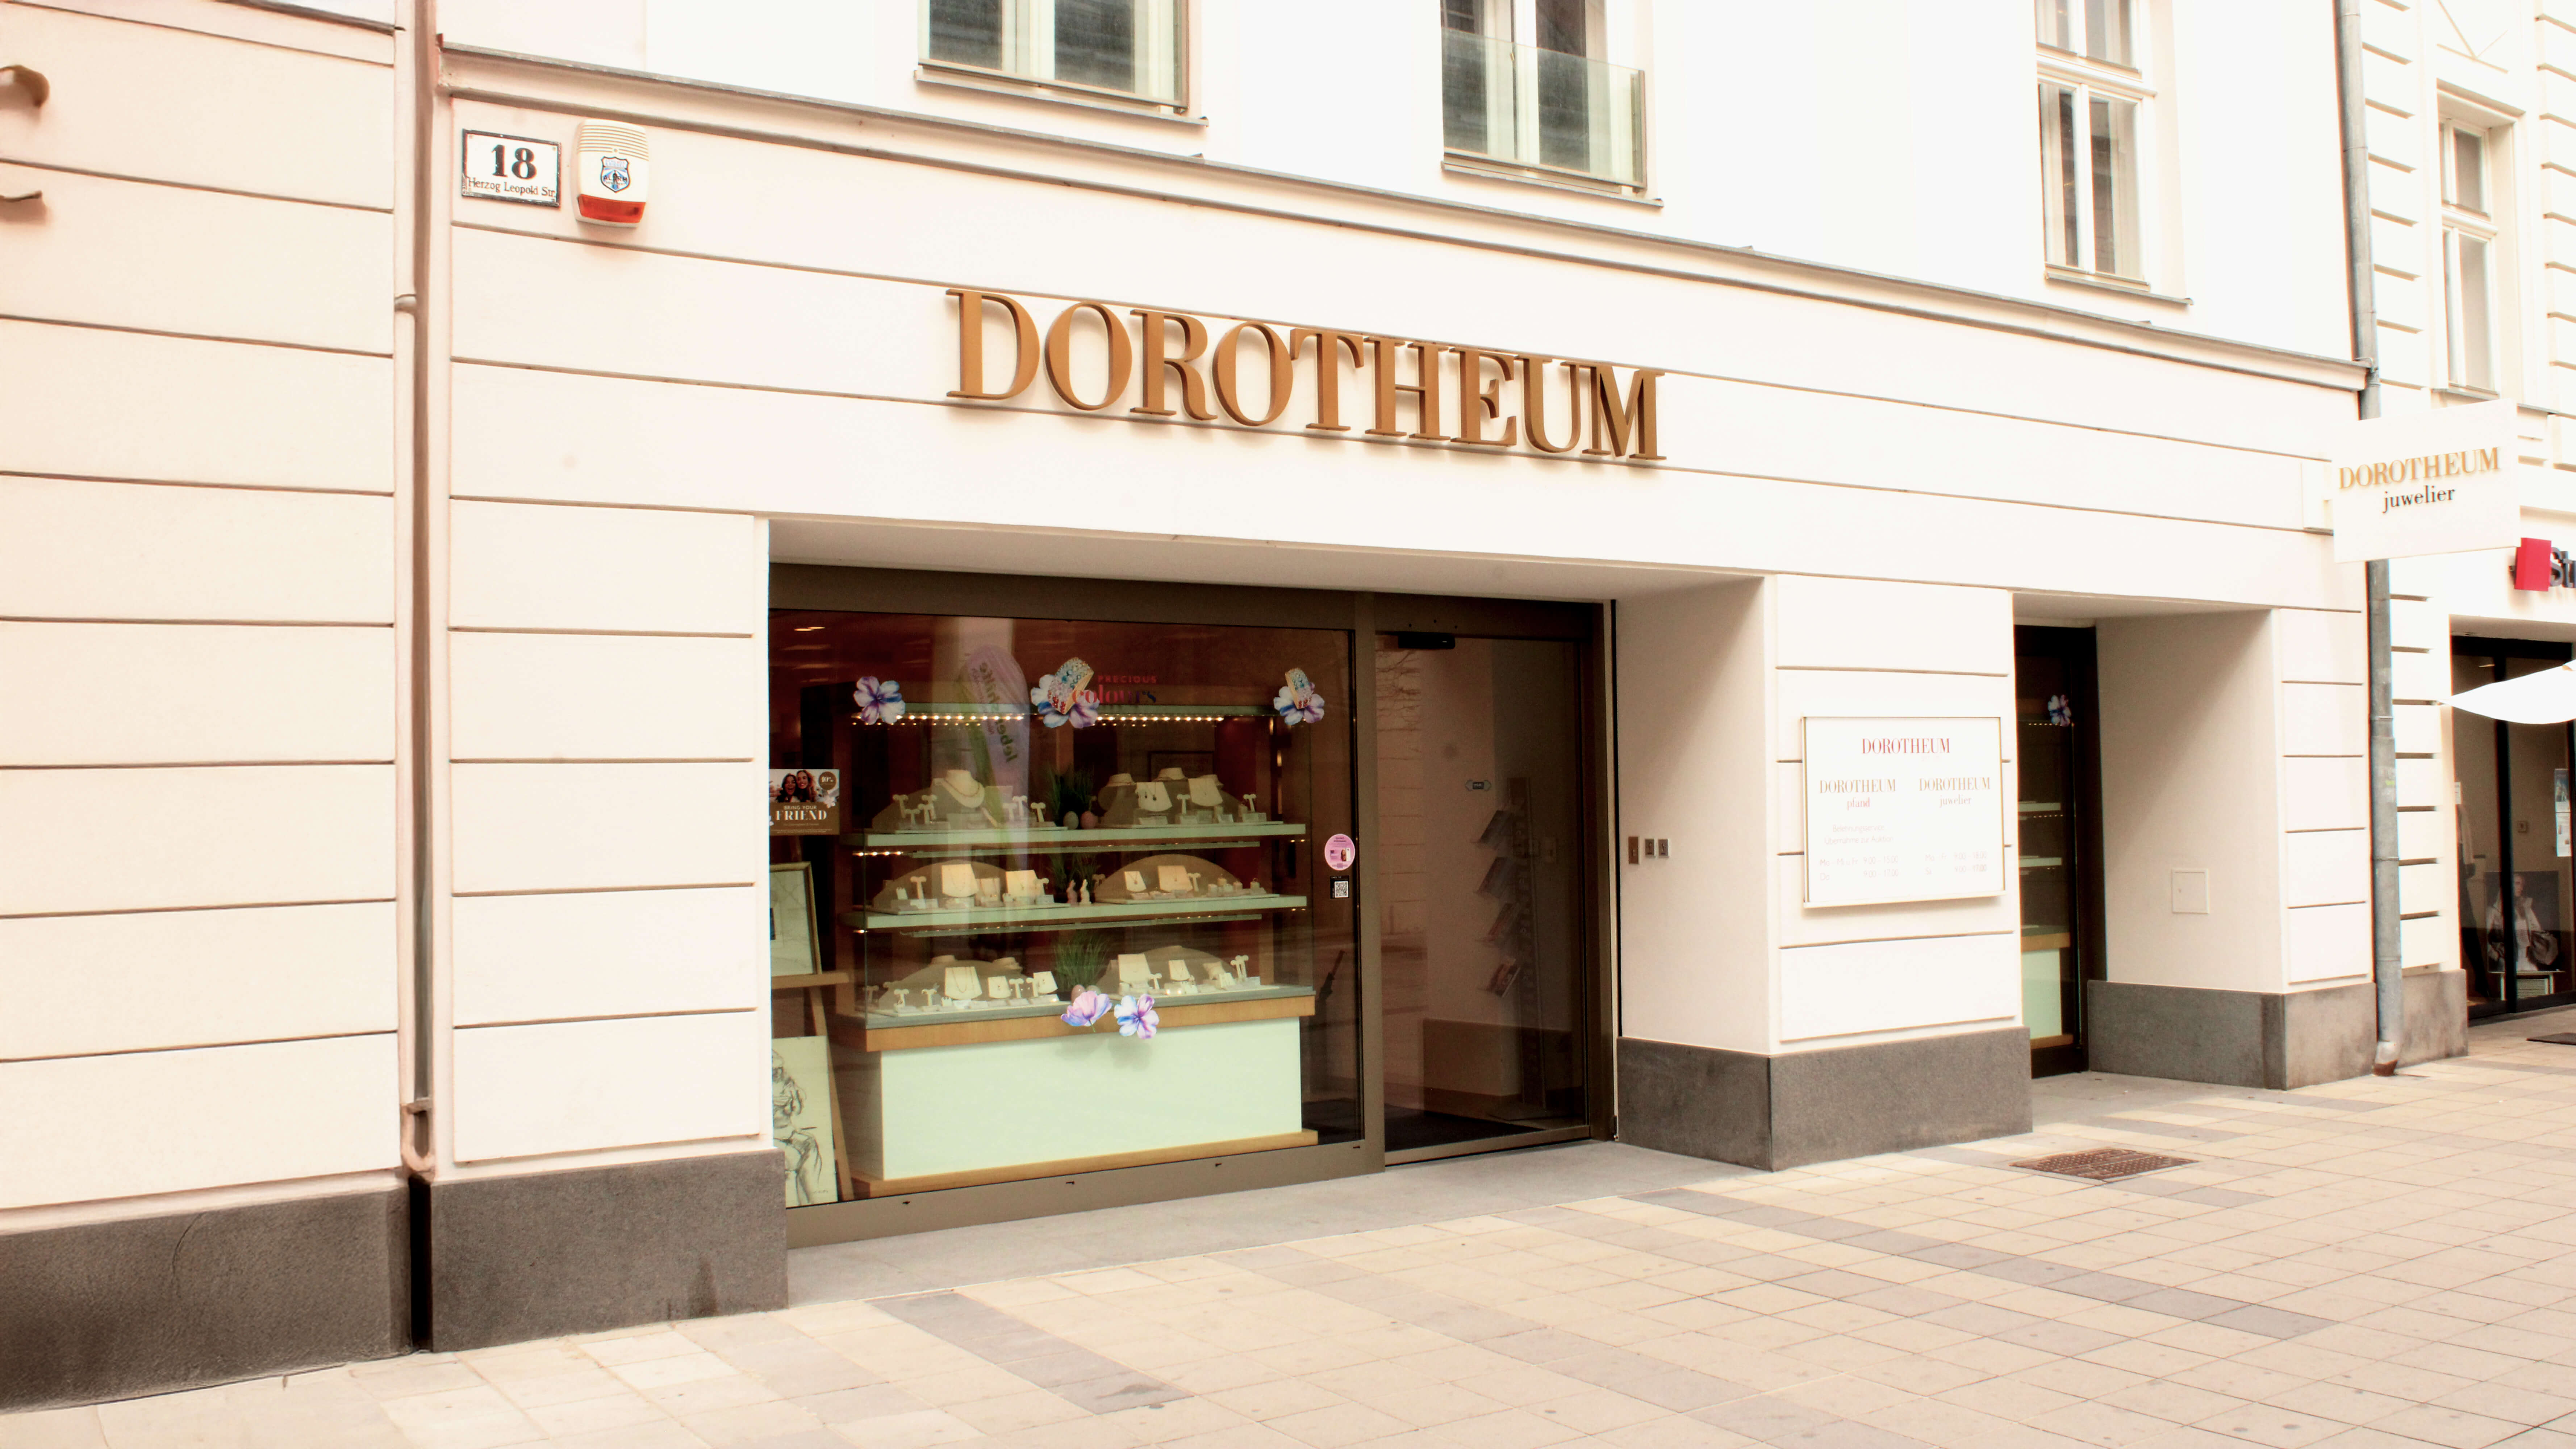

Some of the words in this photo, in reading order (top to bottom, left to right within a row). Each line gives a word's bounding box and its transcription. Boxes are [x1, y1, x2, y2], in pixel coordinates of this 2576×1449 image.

[491, 144, 537, 180] 18
[467, 177, 501, 193] Herzog
[504, 181, 539, 196] Leopold
[541, 186, 557, 198] Str.
[946, 288, 1667, 460] DOROTHEUM
[2338, 447, 2500, 489] DOROTHEUM
[2383, 485, 2455, 514] juwelier
[1098, 675, 1157, 684] PRECIOUS
[1072, 684, 1157, 703] colours
[1862, 738, 1950, 754] DOROTHEUM
[1820, 778, 1896, 793] DOROTHEUM
[1919, 777, 1991, 791] DOROTHEUM
[1847, 797, 1870, 811] pfand
[1940, 794, 1972, 807] juwelier
[776, 810, 827, 820] FRIEND
